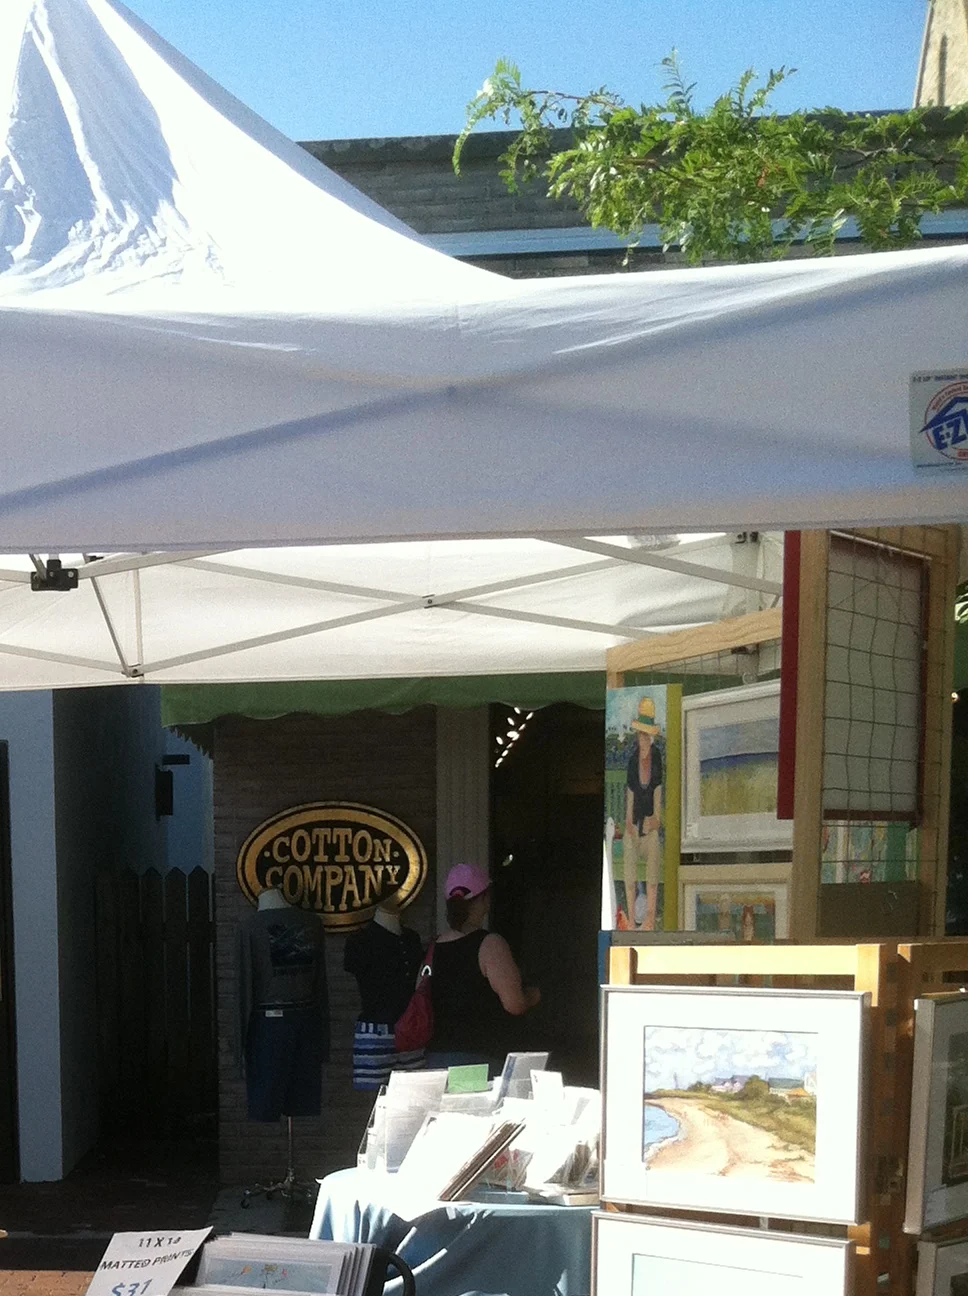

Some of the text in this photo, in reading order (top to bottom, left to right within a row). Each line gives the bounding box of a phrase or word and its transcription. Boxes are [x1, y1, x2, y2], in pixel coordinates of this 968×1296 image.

[272, 827, 392, 863] COTTON
[265, 865, 401, 912] COMPANY
[99, 1249, 195, 1271] MATTED PRINTS
